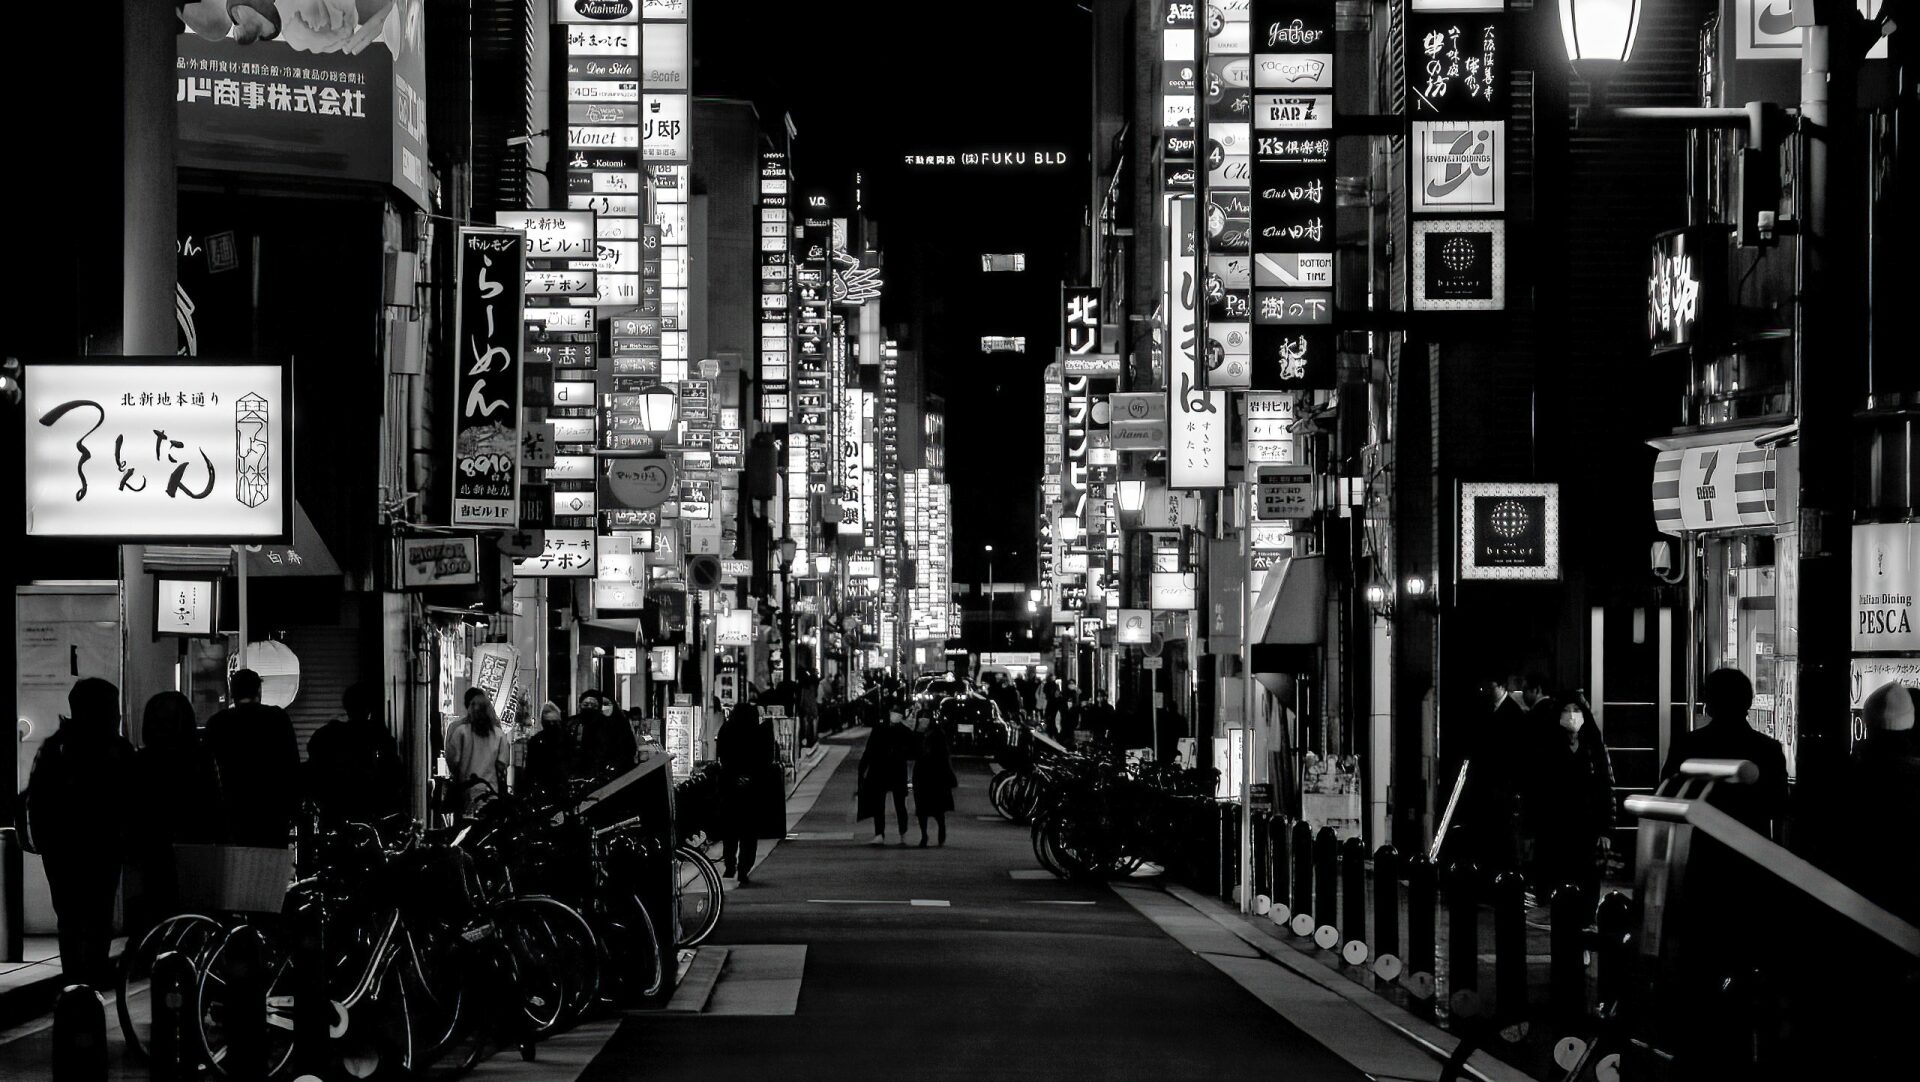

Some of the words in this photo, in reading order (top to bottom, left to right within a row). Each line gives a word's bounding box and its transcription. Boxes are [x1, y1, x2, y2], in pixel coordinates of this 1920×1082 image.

[580, 2, 628, 14] Nashville
[1034, 152, 1067, 165] BLD
[1209, 147, 1222, 163] 4
[524, 218, 566, 230] 北新地
[1306, 272, 1327, 282] TIME
[1261, 296, 1327, 320] 樹の下
[468, 254, 511, 418] らーめん
[121, 392, 220, 406] 北新地本通り
[540, 553, 591, 570] デボン
[1882, 593, 1912, 607] Dining
[1859, 608, 1912, 635] PESCA
